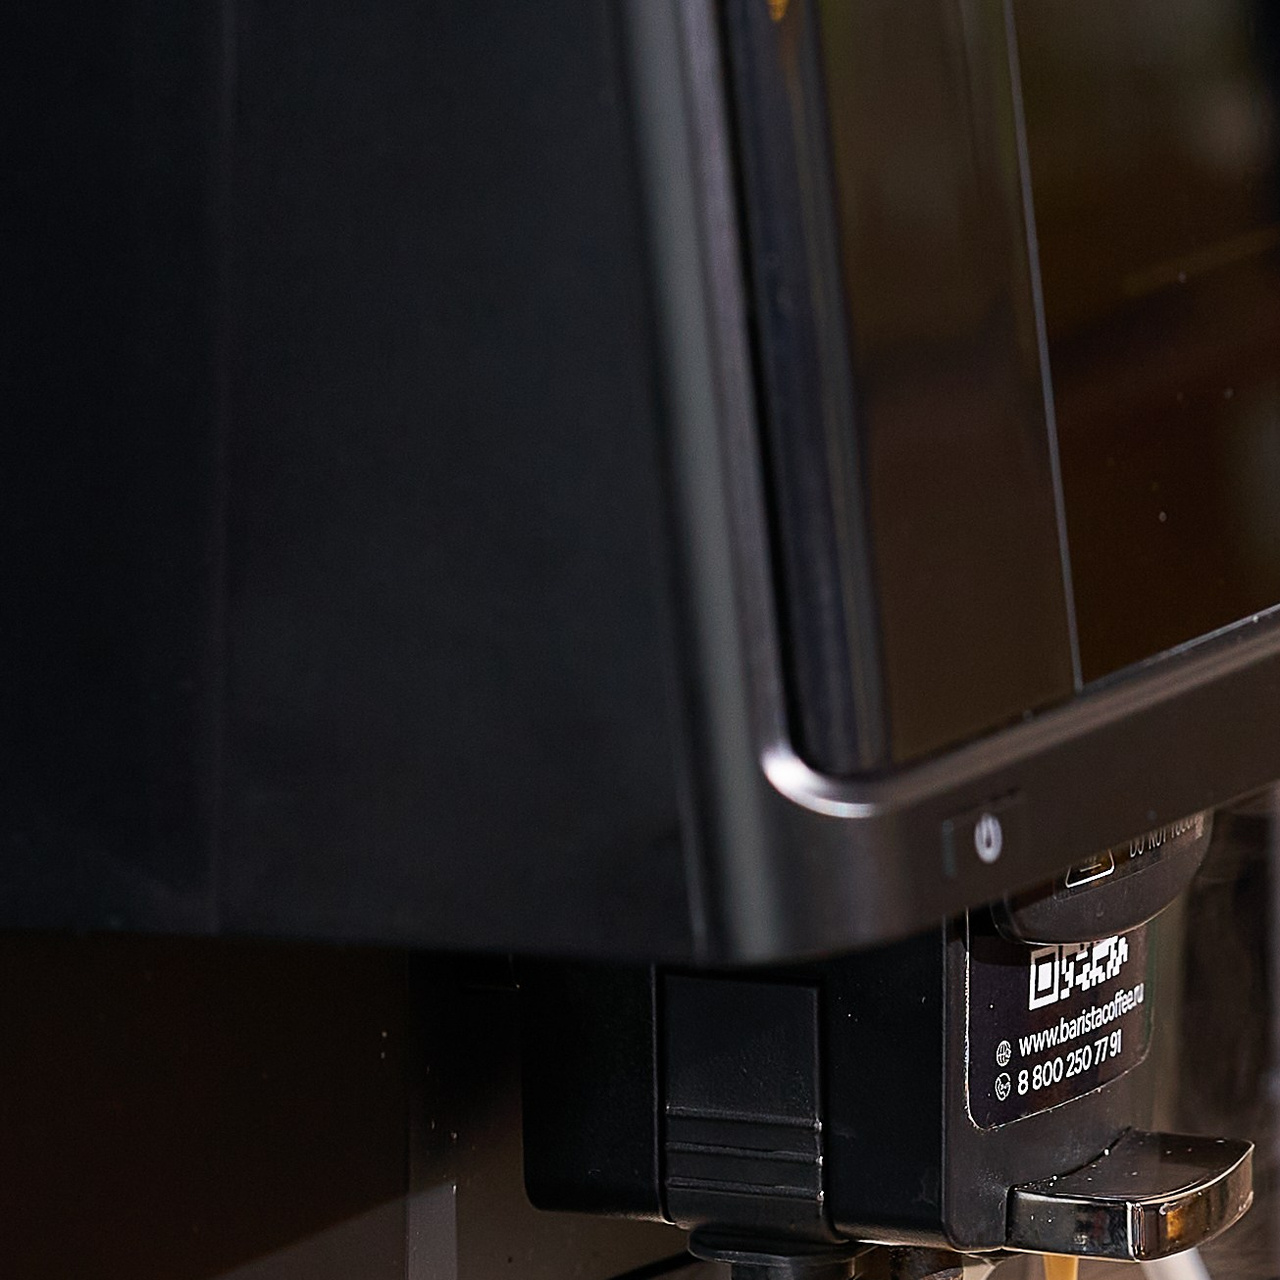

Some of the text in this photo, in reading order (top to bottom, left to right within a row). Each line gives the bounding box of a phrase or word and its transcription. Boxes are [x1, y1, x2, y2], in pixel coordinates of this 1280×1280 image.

[1019, 982, 1145, 1057] www.baristacoffee.ru
[1017, 1069, 1030, 1096] 8
[1032, 1056, 1064, 1092] 800
[1065, 1044, 1094, 1079] 250
